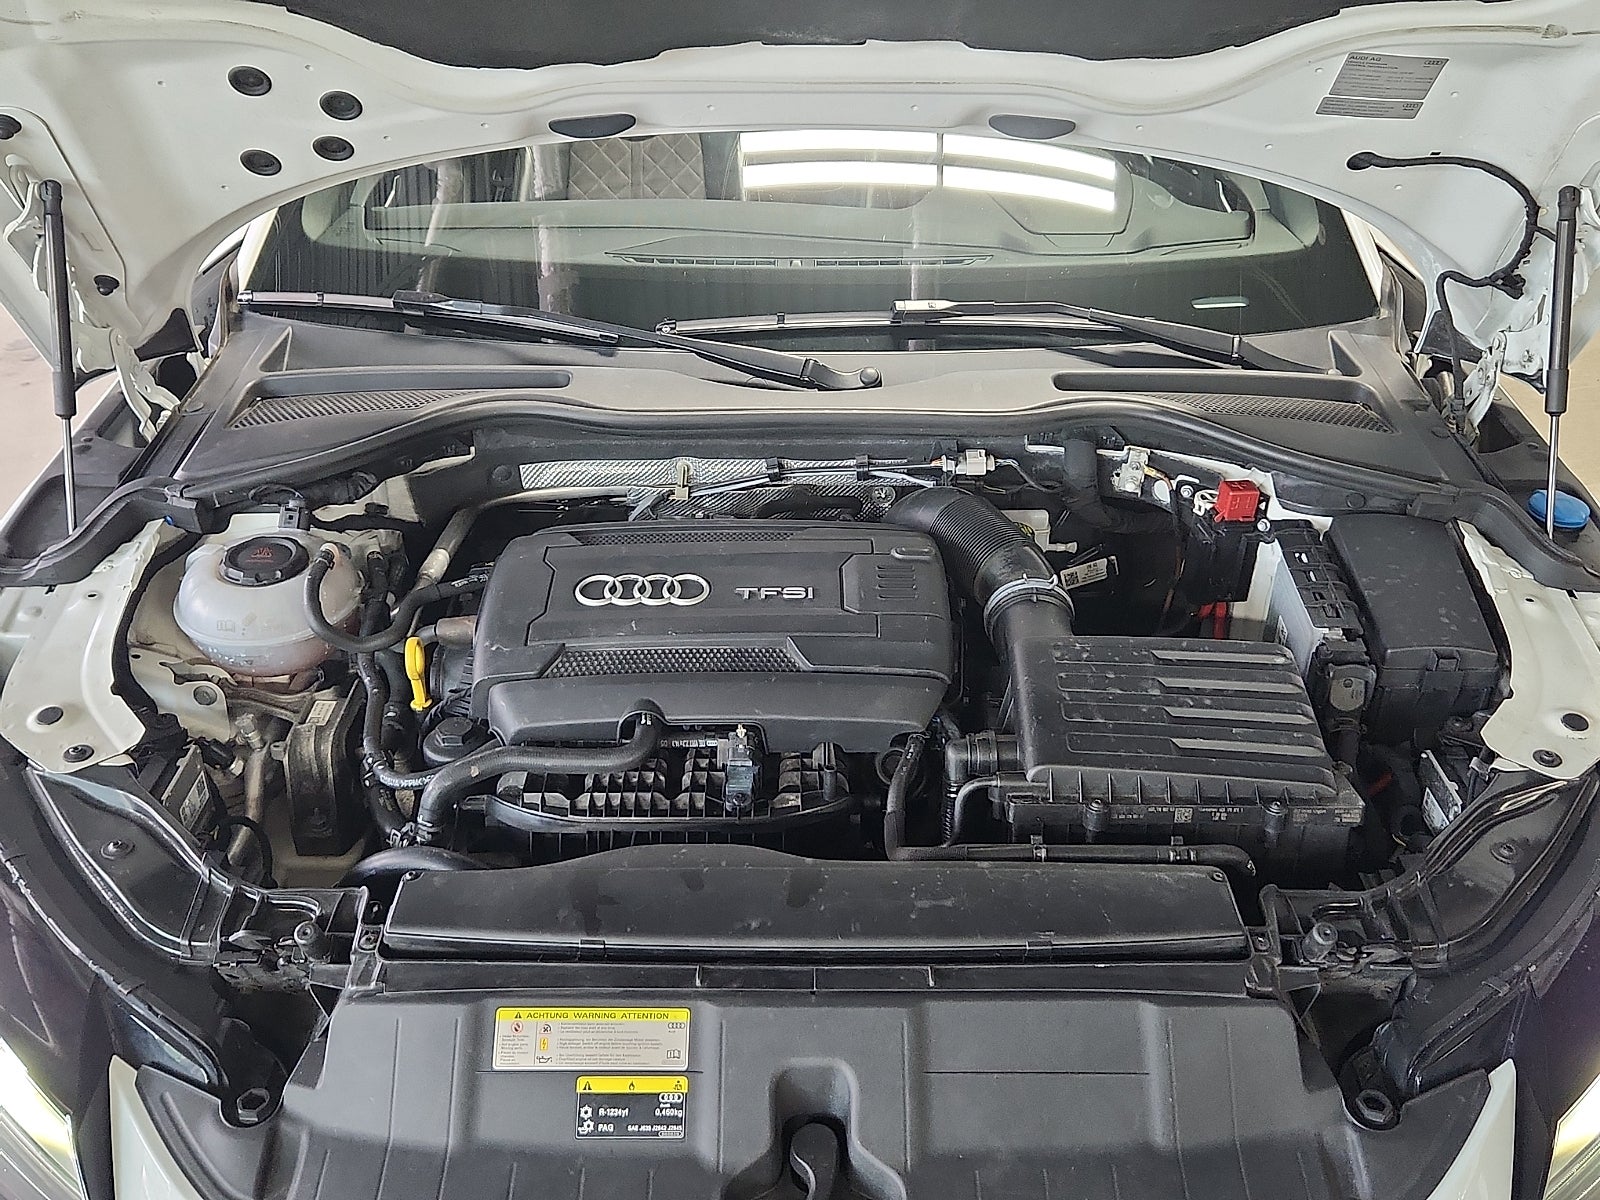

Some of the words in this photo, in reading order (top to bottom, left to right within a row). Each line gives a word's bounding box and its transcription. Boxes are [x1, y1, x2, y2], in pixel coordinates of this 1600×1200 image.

[735, 587, 814, 600] TFSI
[526, 1012, 569, 1020] ACHTUNG
[573, 1012, 617, 1020] WARNING
[620, 1012, 670, 1020] ATTENTION
[598, 1107, 629, 1118] R-1234yf
[597, 1123, 614, 1132] PAG
